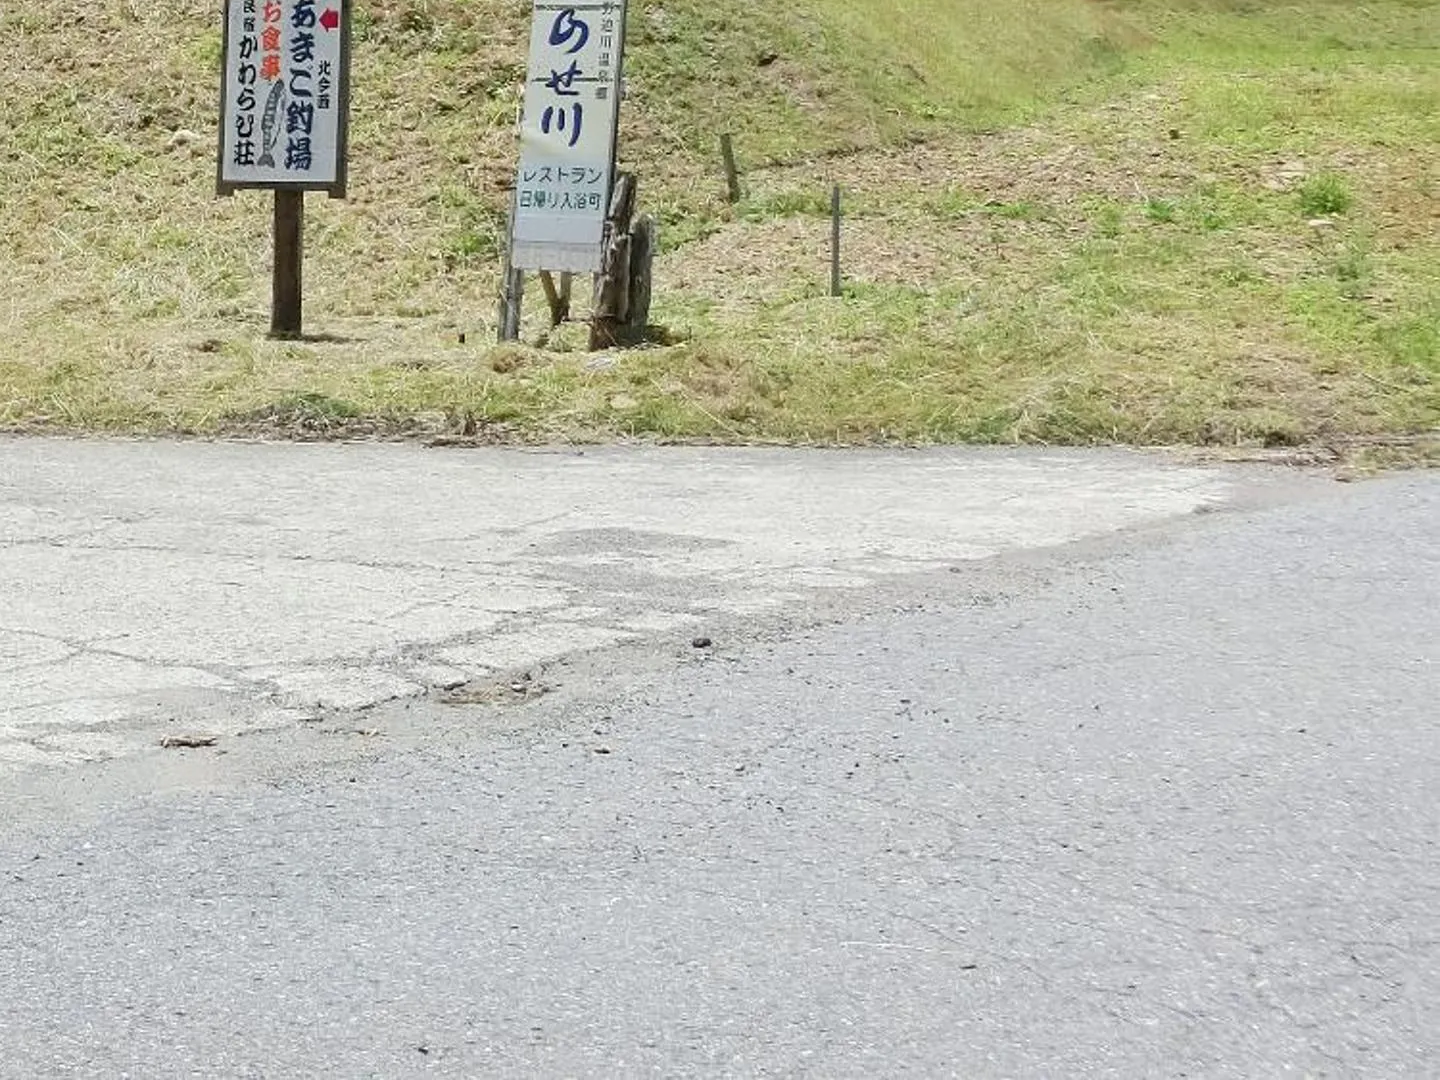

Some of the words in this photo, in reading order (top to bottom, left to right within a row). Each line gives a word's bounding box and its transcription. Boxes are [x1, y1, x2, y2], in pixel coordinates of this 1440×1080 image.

[261, 0, 282, 81] お食事
[542, 8, 589, 147] のせ川
[519, 189, 602, 211] 日帰り入浴可
[523, 166, 603, 185] レストラン
